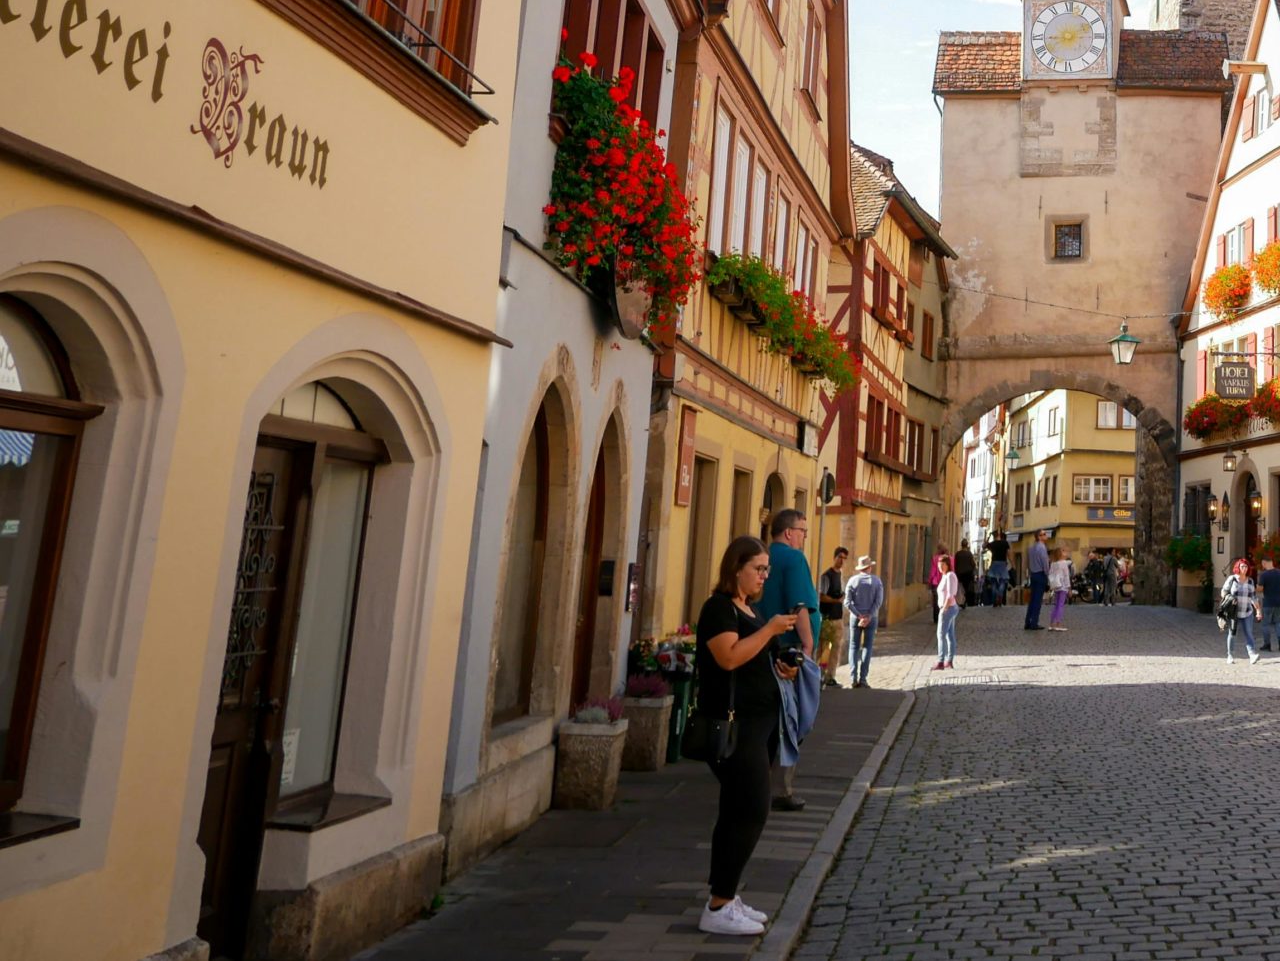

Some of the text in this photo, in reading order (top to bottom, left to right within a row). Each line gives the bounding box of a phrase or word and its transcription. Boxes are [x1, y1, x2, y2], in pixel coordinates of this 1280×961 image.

[190, 37, 331, 190] Braun
[1221, 366, 1249, 378] HOTEL
[1226, 386, 1246, 395] TURM
